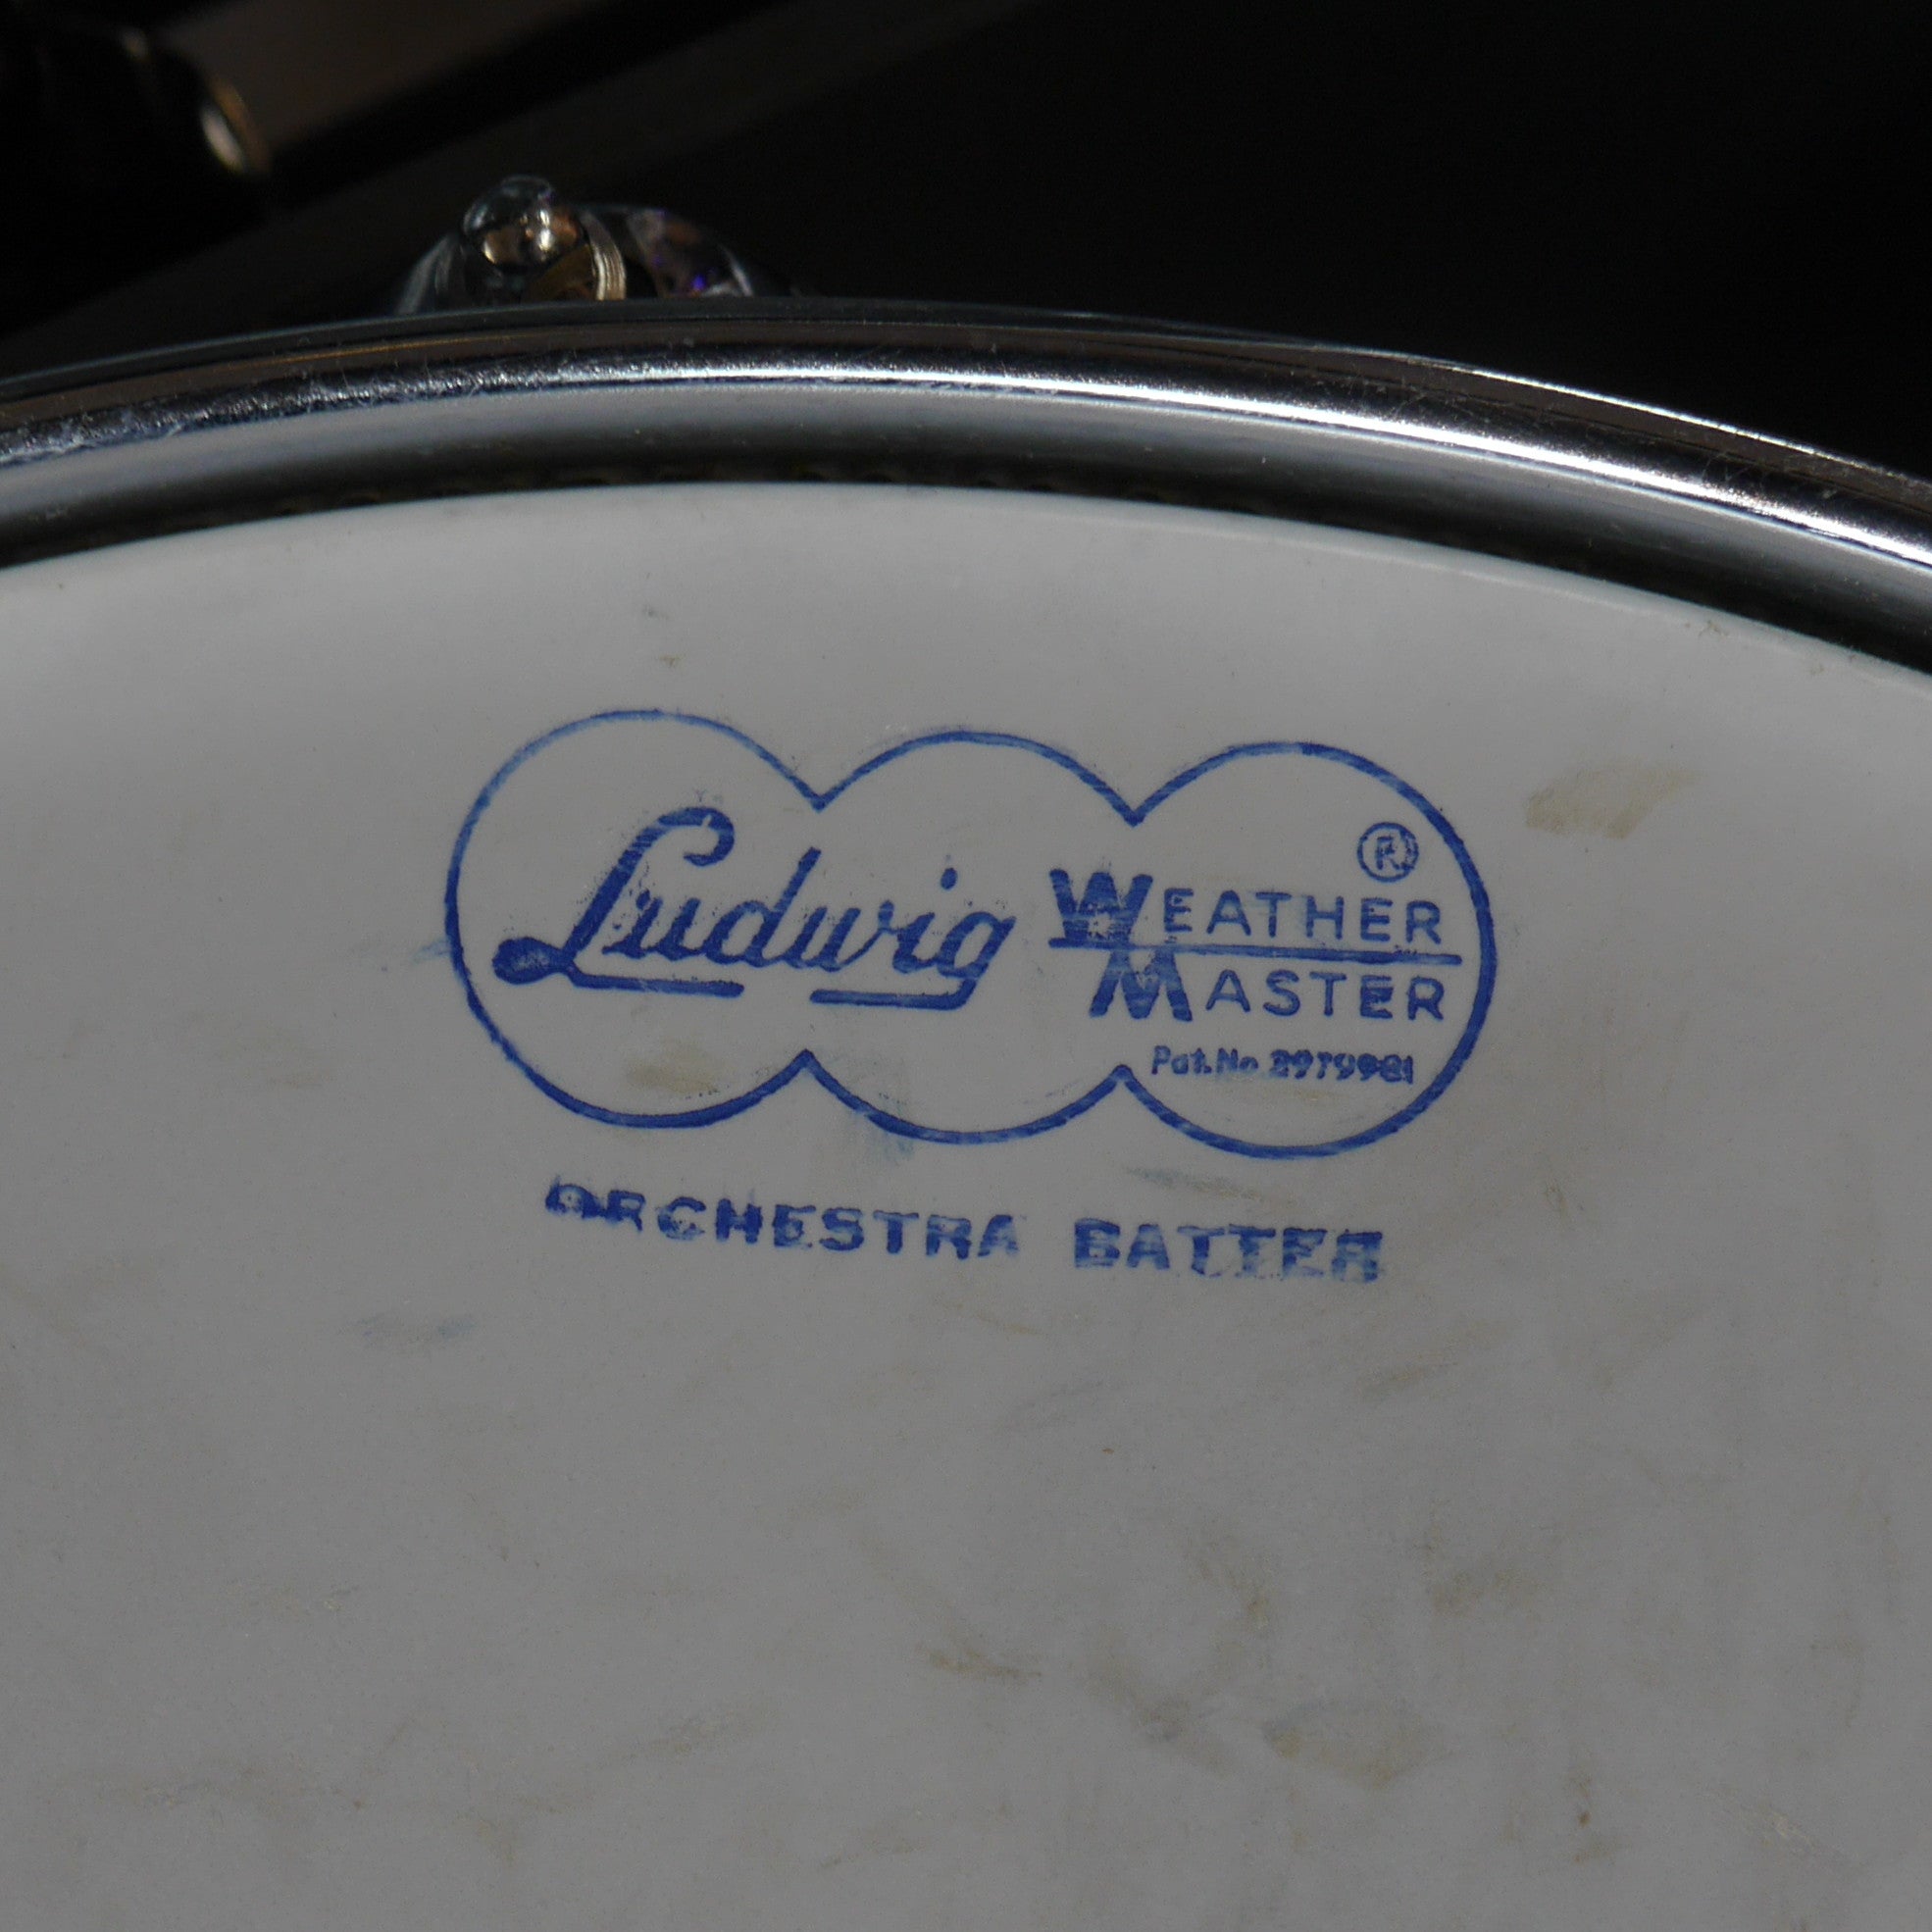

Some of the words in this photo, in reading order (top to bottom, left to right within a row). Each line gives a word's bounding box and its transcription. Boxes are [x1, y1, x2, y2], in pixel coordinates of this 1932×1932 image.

[492, 806, 1016, 1010] Ludwig
[1048, 868, 1442, 944] WEATHER
[1089, 947, 1446, 1022] MASTER
[544, 1182, 1020, 1259] ORCHESTRA
[1074, 1216, 1384, 1283] BATTER
